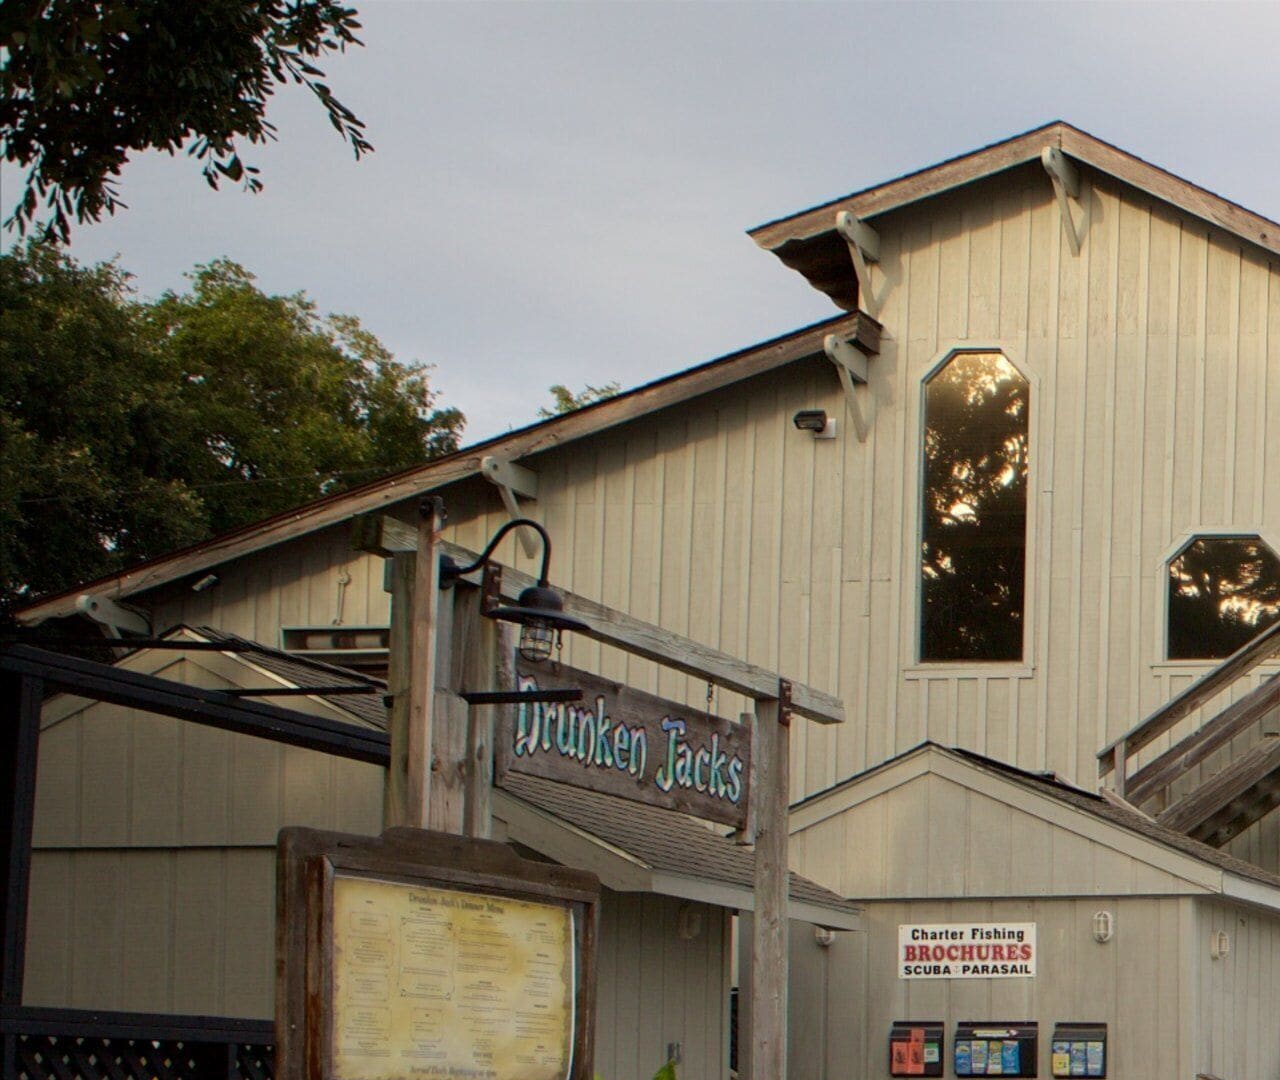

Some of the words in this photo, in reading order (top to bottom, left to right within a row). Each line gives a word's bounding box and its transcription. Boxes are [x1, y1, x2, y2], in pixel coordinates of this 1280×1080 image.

[515, 674, 647, 780] Drunken
[655, 716, 743, 803] Jacks
[911, 929, 964, 940] Charter
[971, 928, 1024, 942] Fishing
[904, 944, 1032, 962] BROCHURES
[904, 965, 951, 975] SCUBA
[962, 965, 1031, 975] PARASAIL
